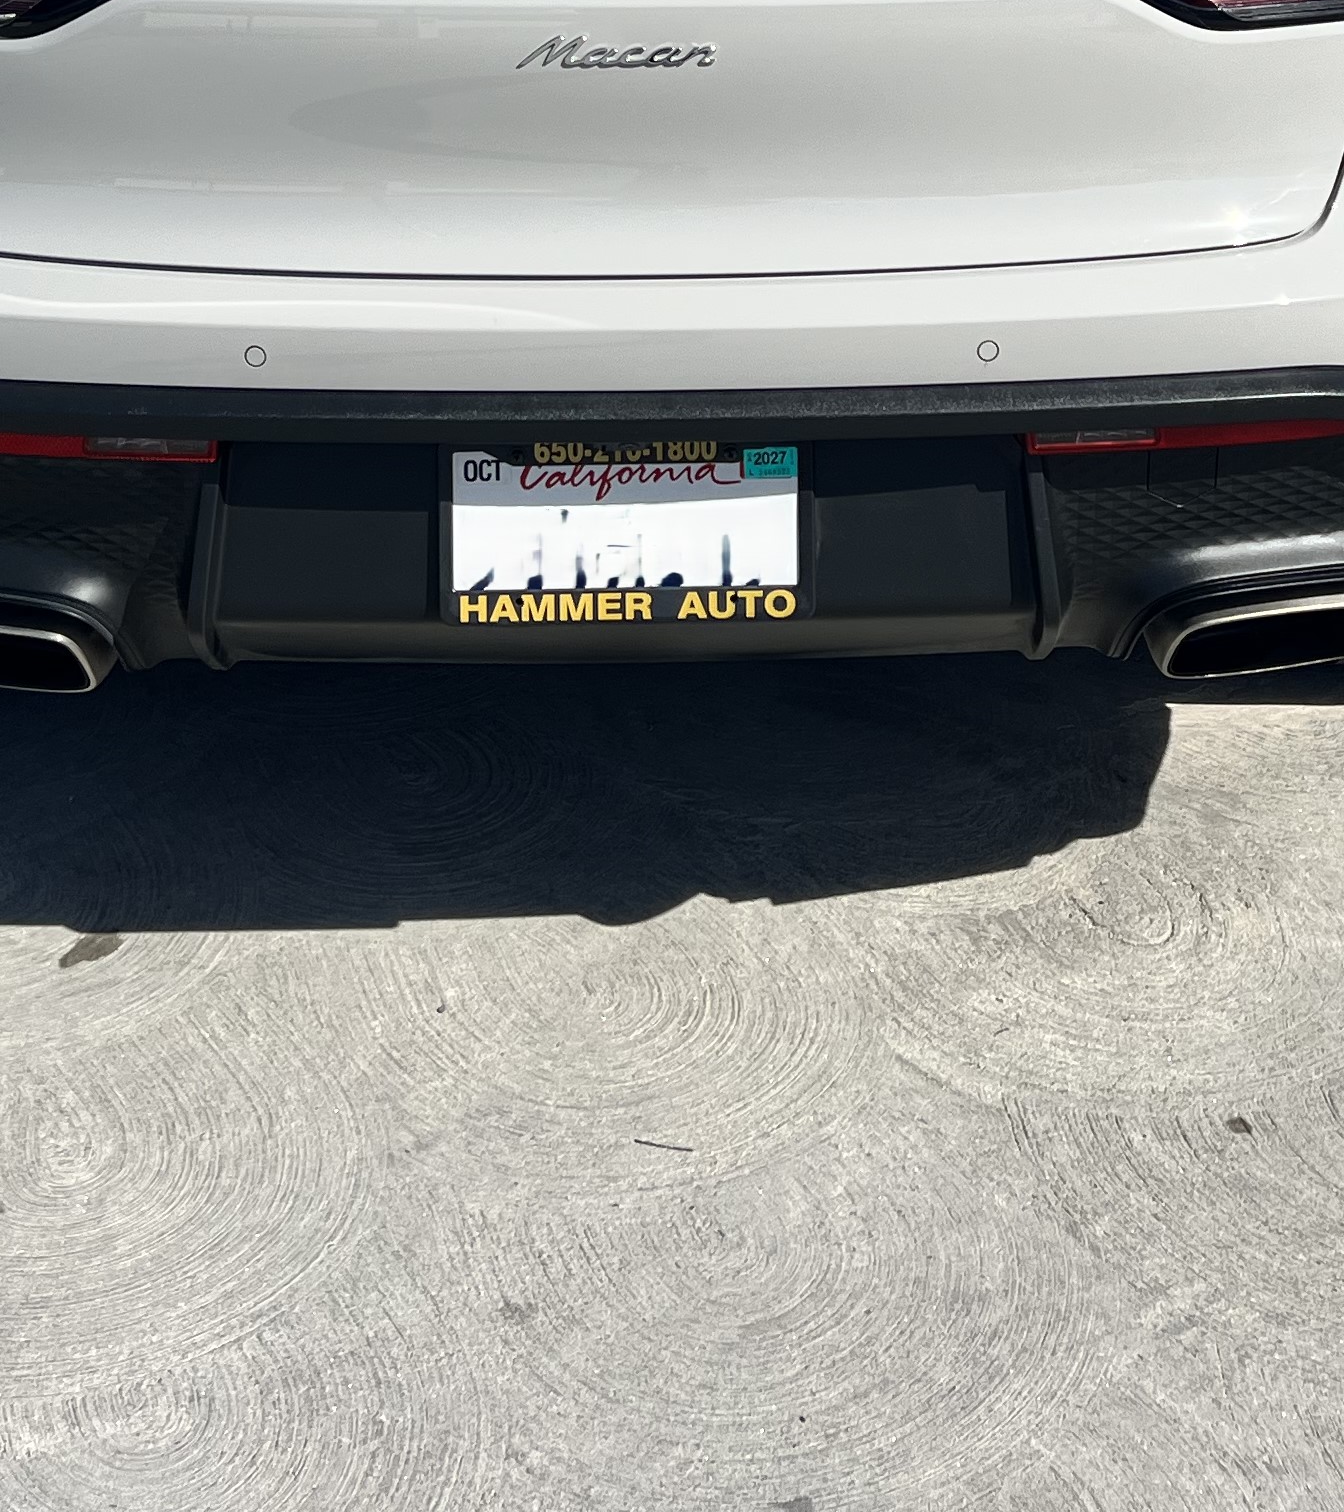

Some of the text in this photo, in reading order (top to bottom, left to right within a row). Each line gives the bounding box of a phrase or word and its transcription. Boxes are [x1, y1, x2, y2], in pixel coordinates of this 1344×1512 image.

[514, 33, 719, 70] Macan
[463, 459, 502, 483] OCT
[753, 450, 787, 466] 2027
[519, 461, 742, 502] California
[458, 588, 797, 624] HAMMER AUTO
